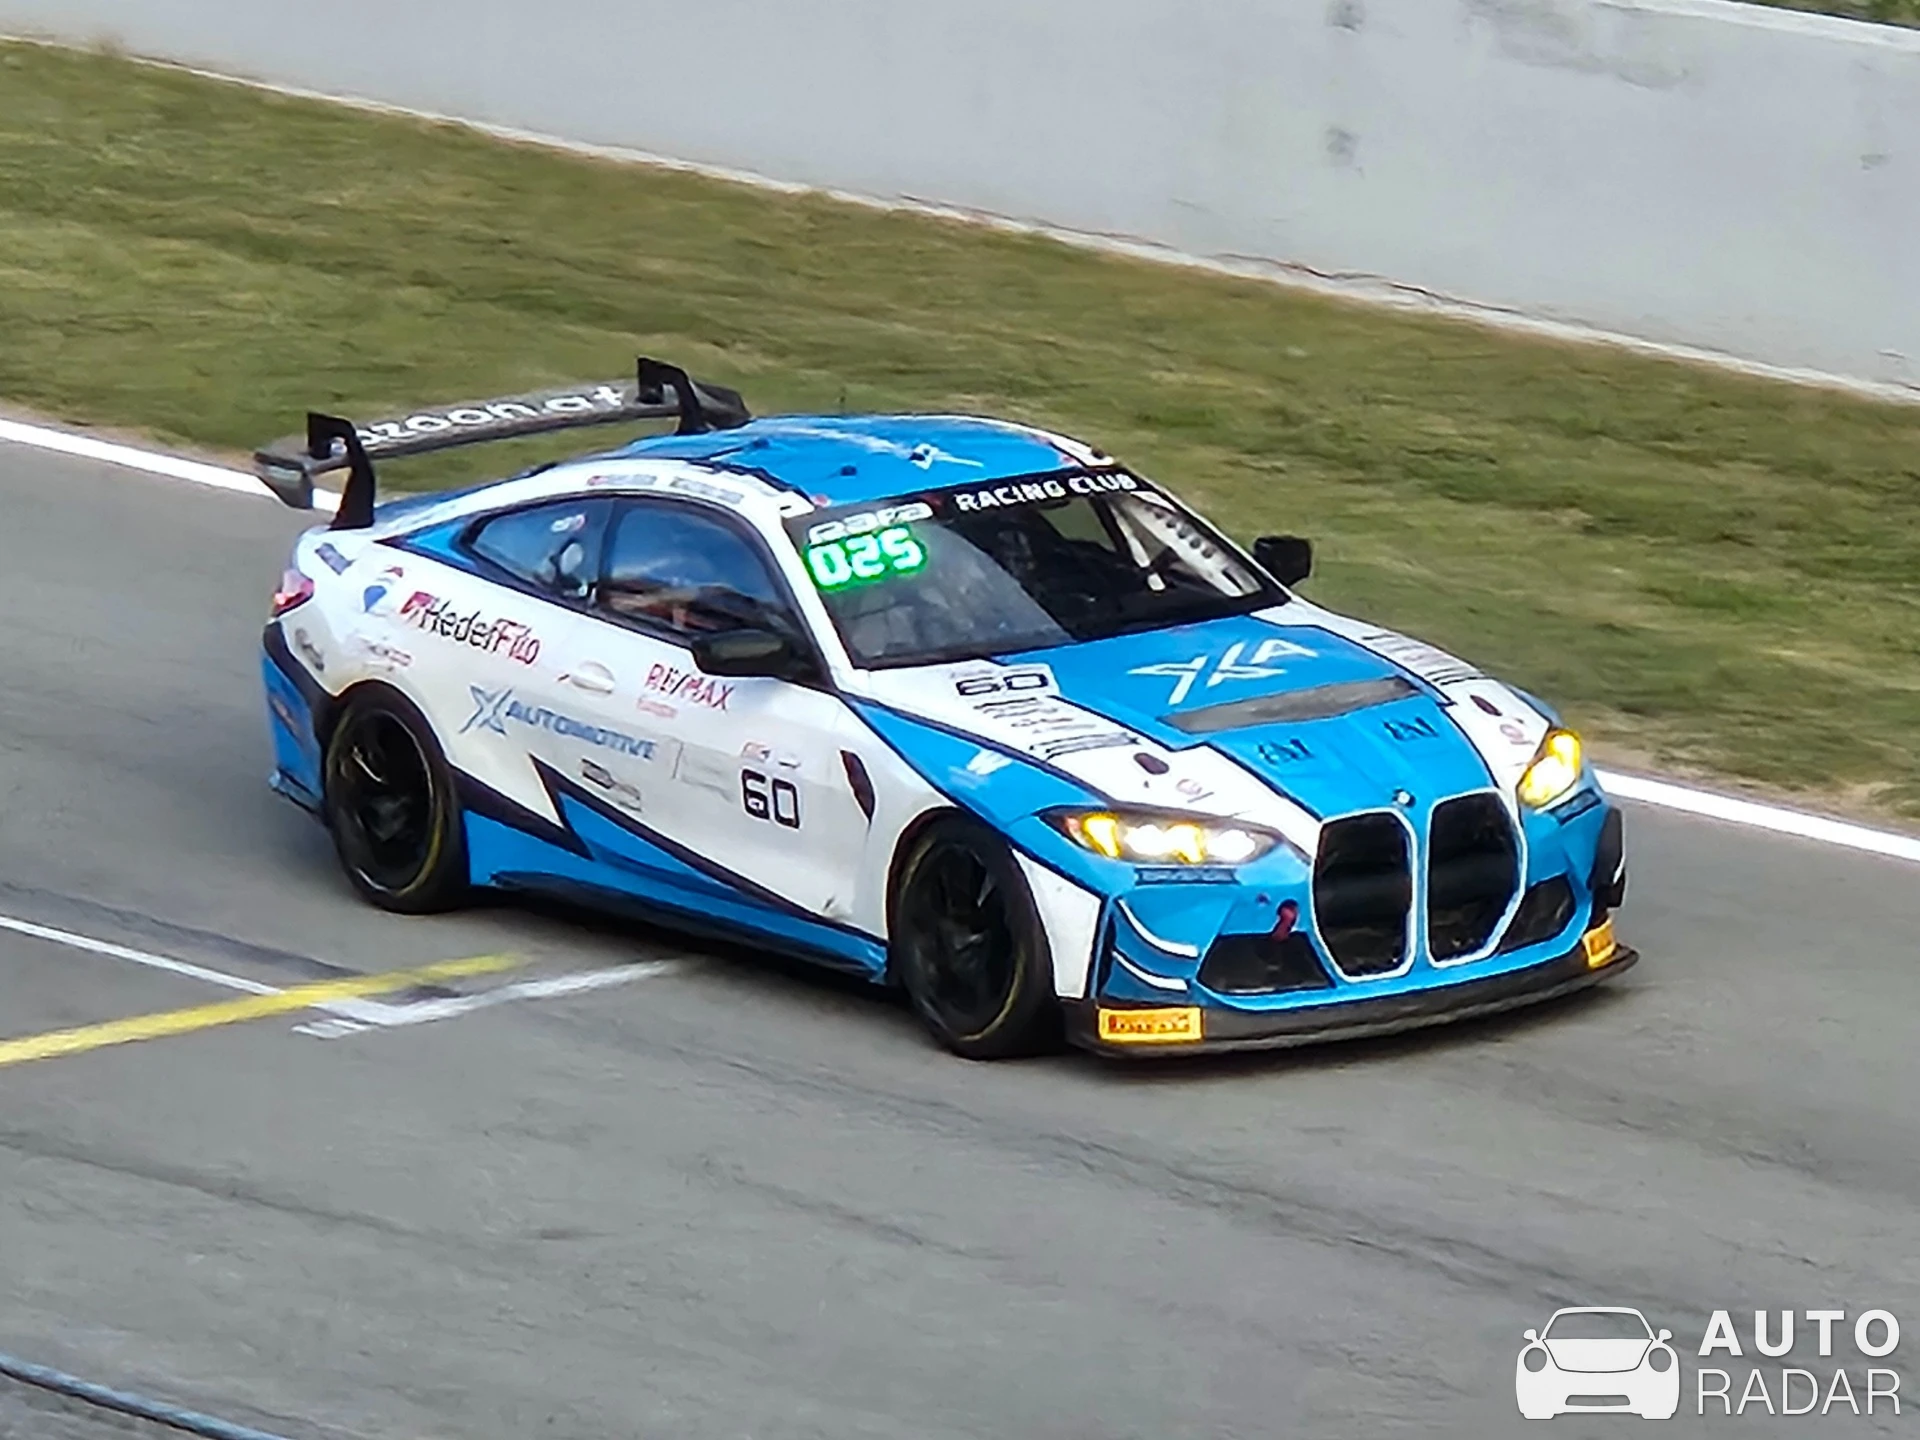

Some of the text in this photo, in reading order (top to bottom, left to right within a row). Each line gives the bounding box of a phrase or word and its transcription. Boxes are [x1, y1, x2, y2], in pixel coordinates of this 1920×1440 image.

[954, 480, 1067, 511] RACING
[1068, 473, 1138, 494] CLUB
[808, 527, 923, 587] 025
[956, 674, 1049, 696] 60
[741, 768, 801, 830] 60
